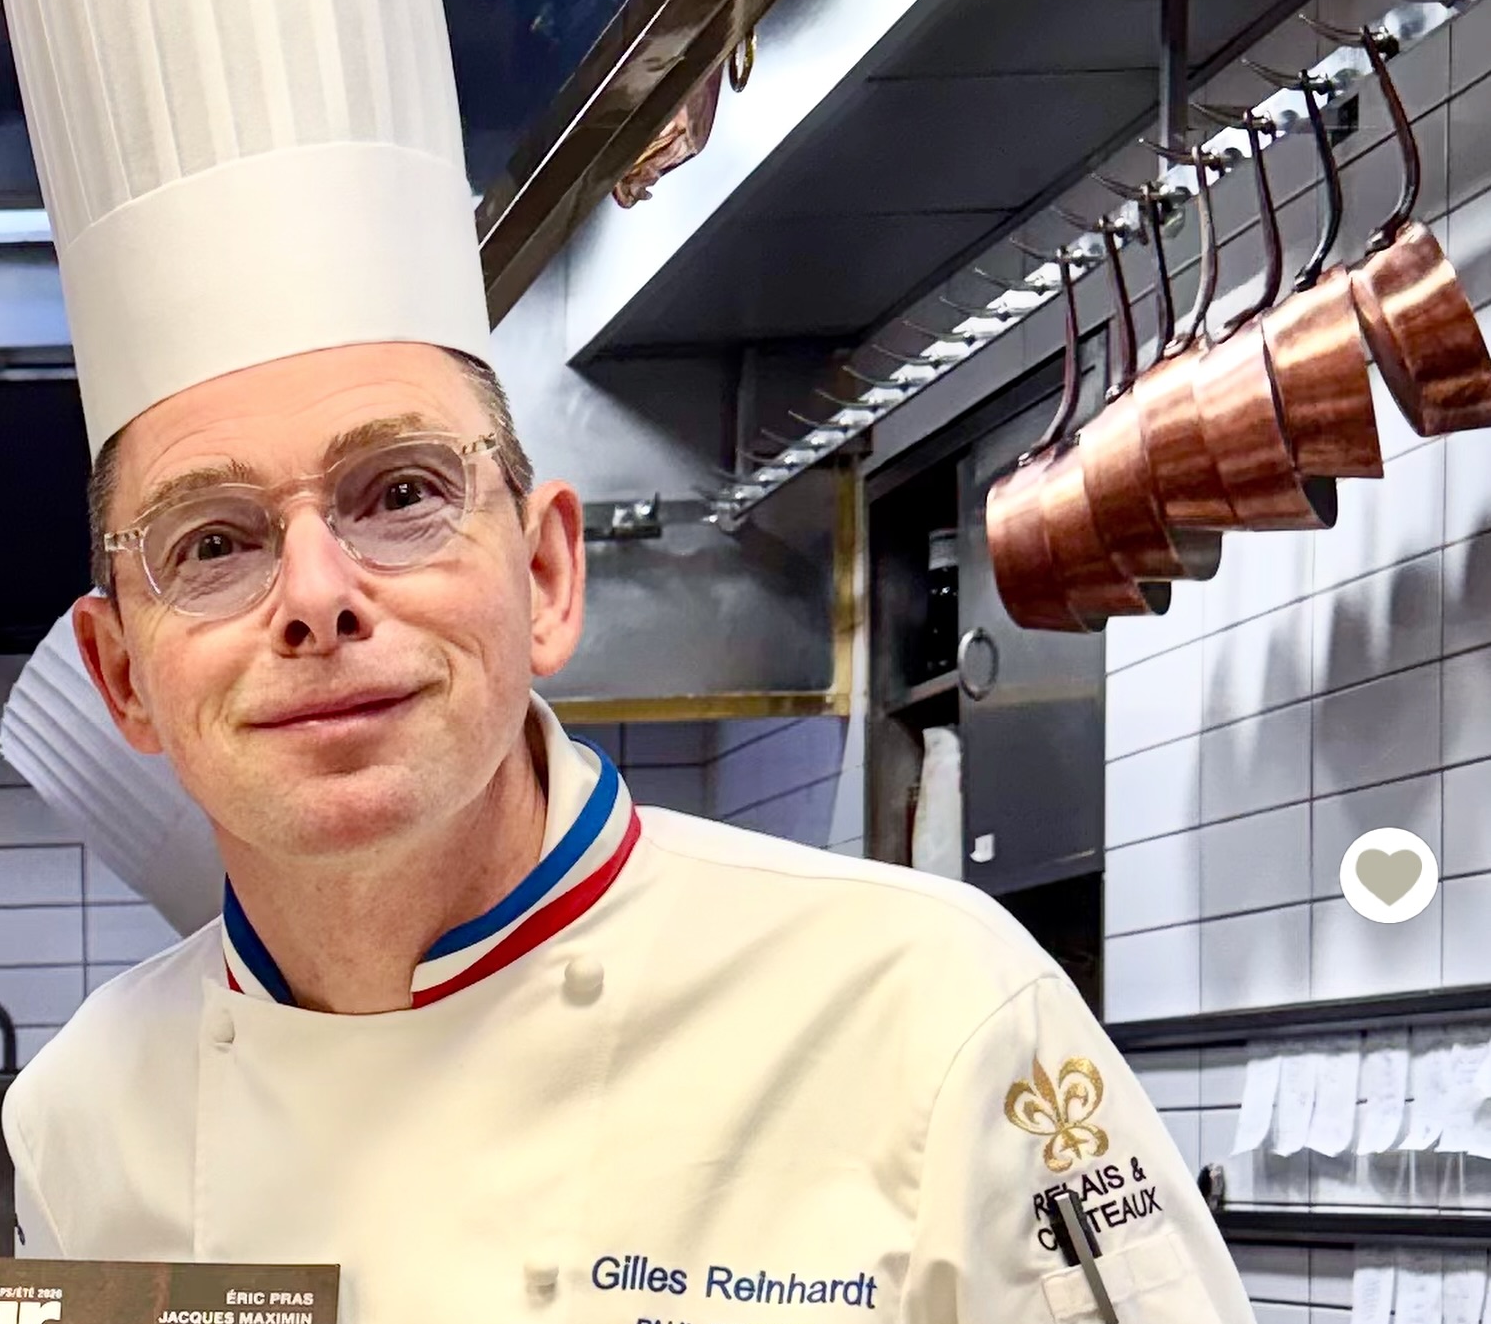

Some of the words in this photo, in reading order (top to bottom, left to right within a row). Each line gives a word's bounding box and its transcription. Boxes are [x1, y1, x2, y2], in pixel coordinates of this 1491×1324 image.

[1130, 1156, 1146, 1182] &
[1037, 1186, 1162, 1251] CTEAUX
[592, 1255, 687, 1295] Gilles
[705, 1265, 877, 1309] Reinhardt
[226, 1288, 265, 1305] ÉRIC
[270, 1292, 314, 1305] PRAS
[159, 1311, 234, 1324] JACQUES
